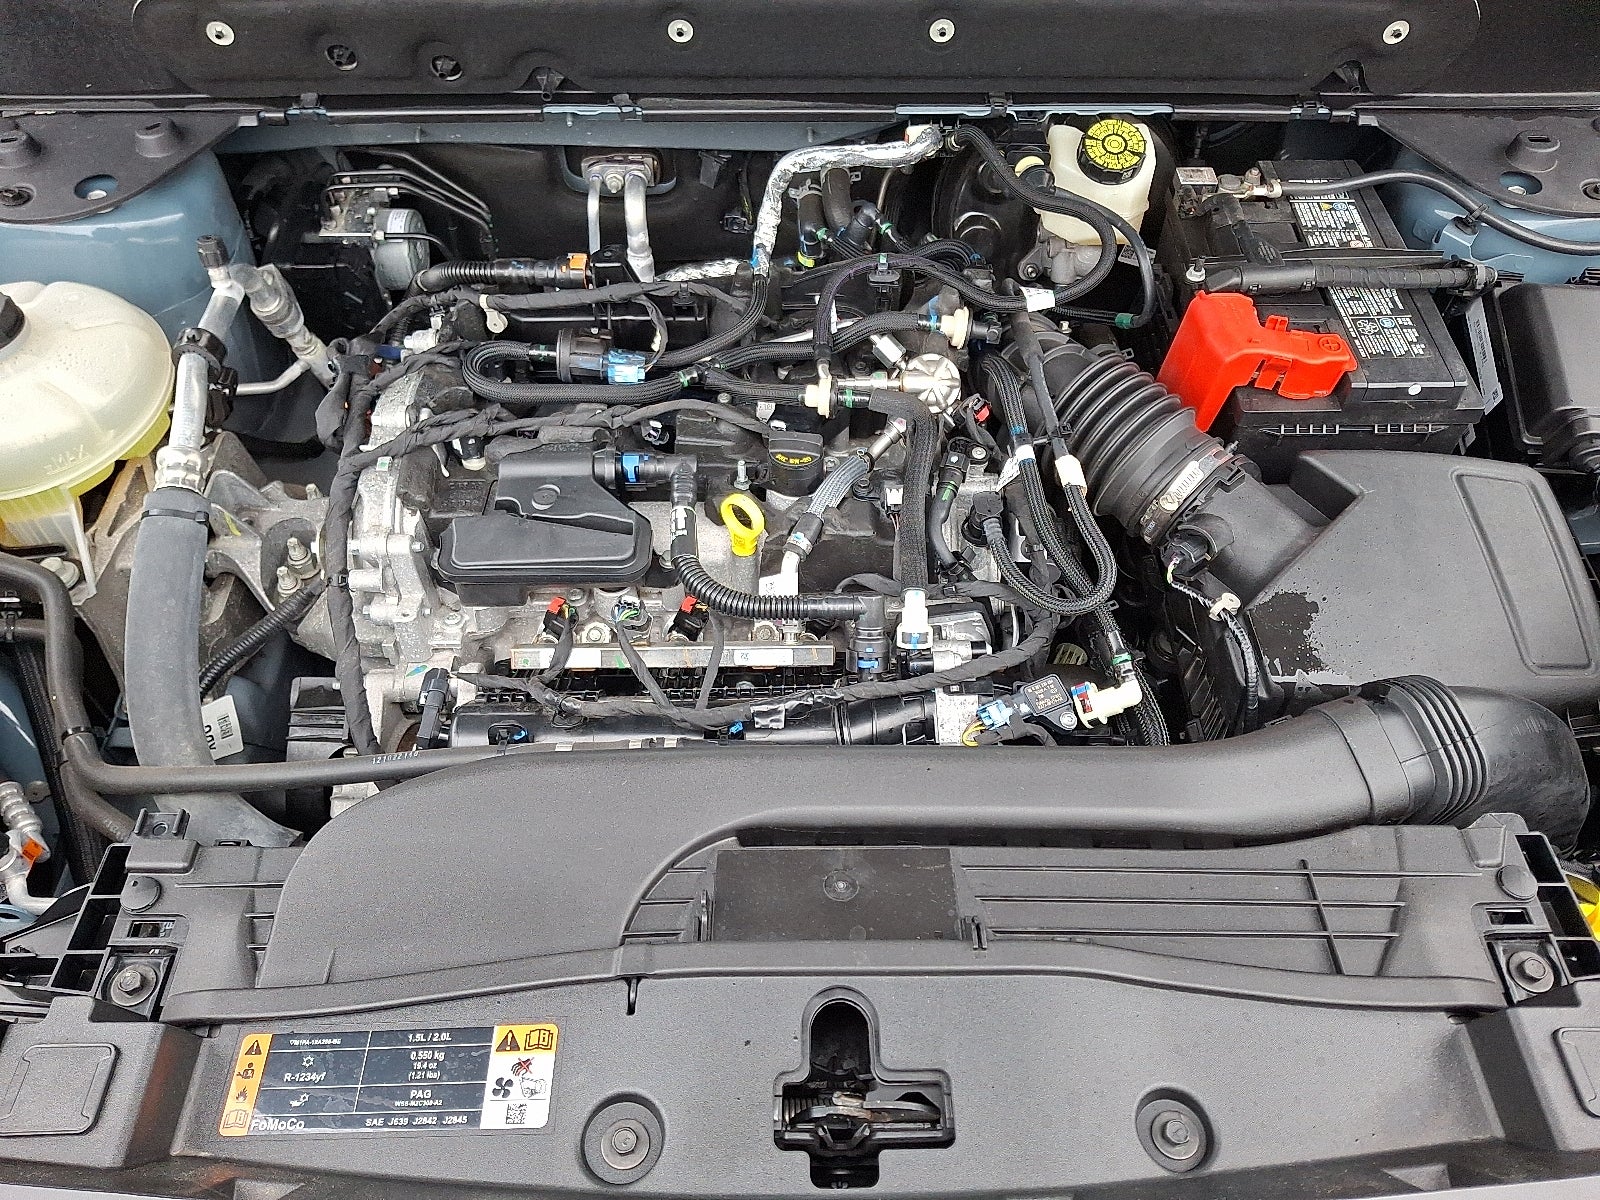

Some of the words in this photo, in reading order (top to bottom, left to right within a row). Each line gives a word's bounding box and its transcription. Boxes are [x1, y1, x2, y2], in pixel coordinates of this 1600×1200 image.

[408, 1034, 426, 1042] 1.5L
[433, 1033, 451, 1041] 2.0L
[410, 1051, 433, 1060] 0.550
[434, 1051, 445, 1061] kg
[284, 1072, 326, 1083] R-1234yf
[408, 1072, 425, 1081] (1.21
[426, 1071, 440, 1080] lbs)
[410, 1090, 431, 1099] PAG
[251, 1118, 305, 1130] FoMoCo
[365, 1118, 384, 1126] SAE
[388, 1117, 408, 1125] J639
[413, 1117, 437, 1125] J2842
[442, 1116, 468, 1124] J2845
